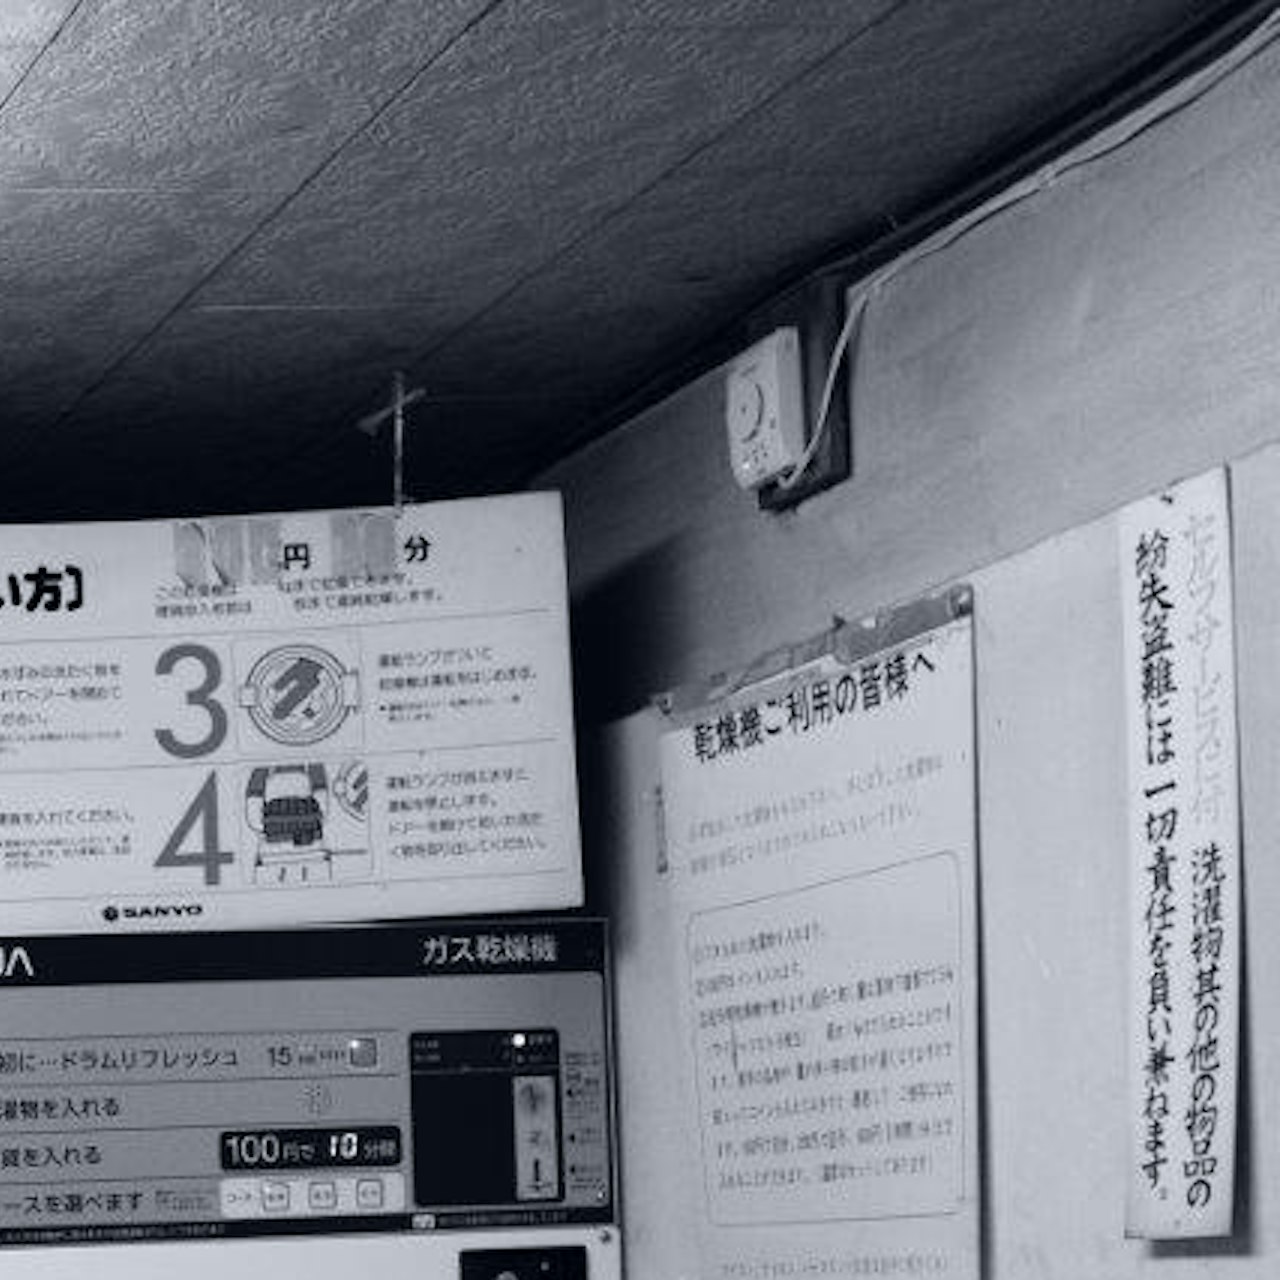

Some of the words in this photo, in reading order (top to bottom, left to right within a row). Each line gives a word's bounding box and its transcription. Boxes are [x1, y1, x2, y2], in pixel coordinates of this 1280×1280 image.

[283, 542, 311, 571] 円
[403, 535, 432, 564] 分
[154, 643, 228, 759] 3
[693, 651, 938, 765] 乾燥機ご利用の皆様へ
[153, 769, 235, 886] 4
[122, 904, 204, 920] SANYO
[422, 933, 559, 965] ガス乾燥機
[267, 1046, 294, 1067] 15
